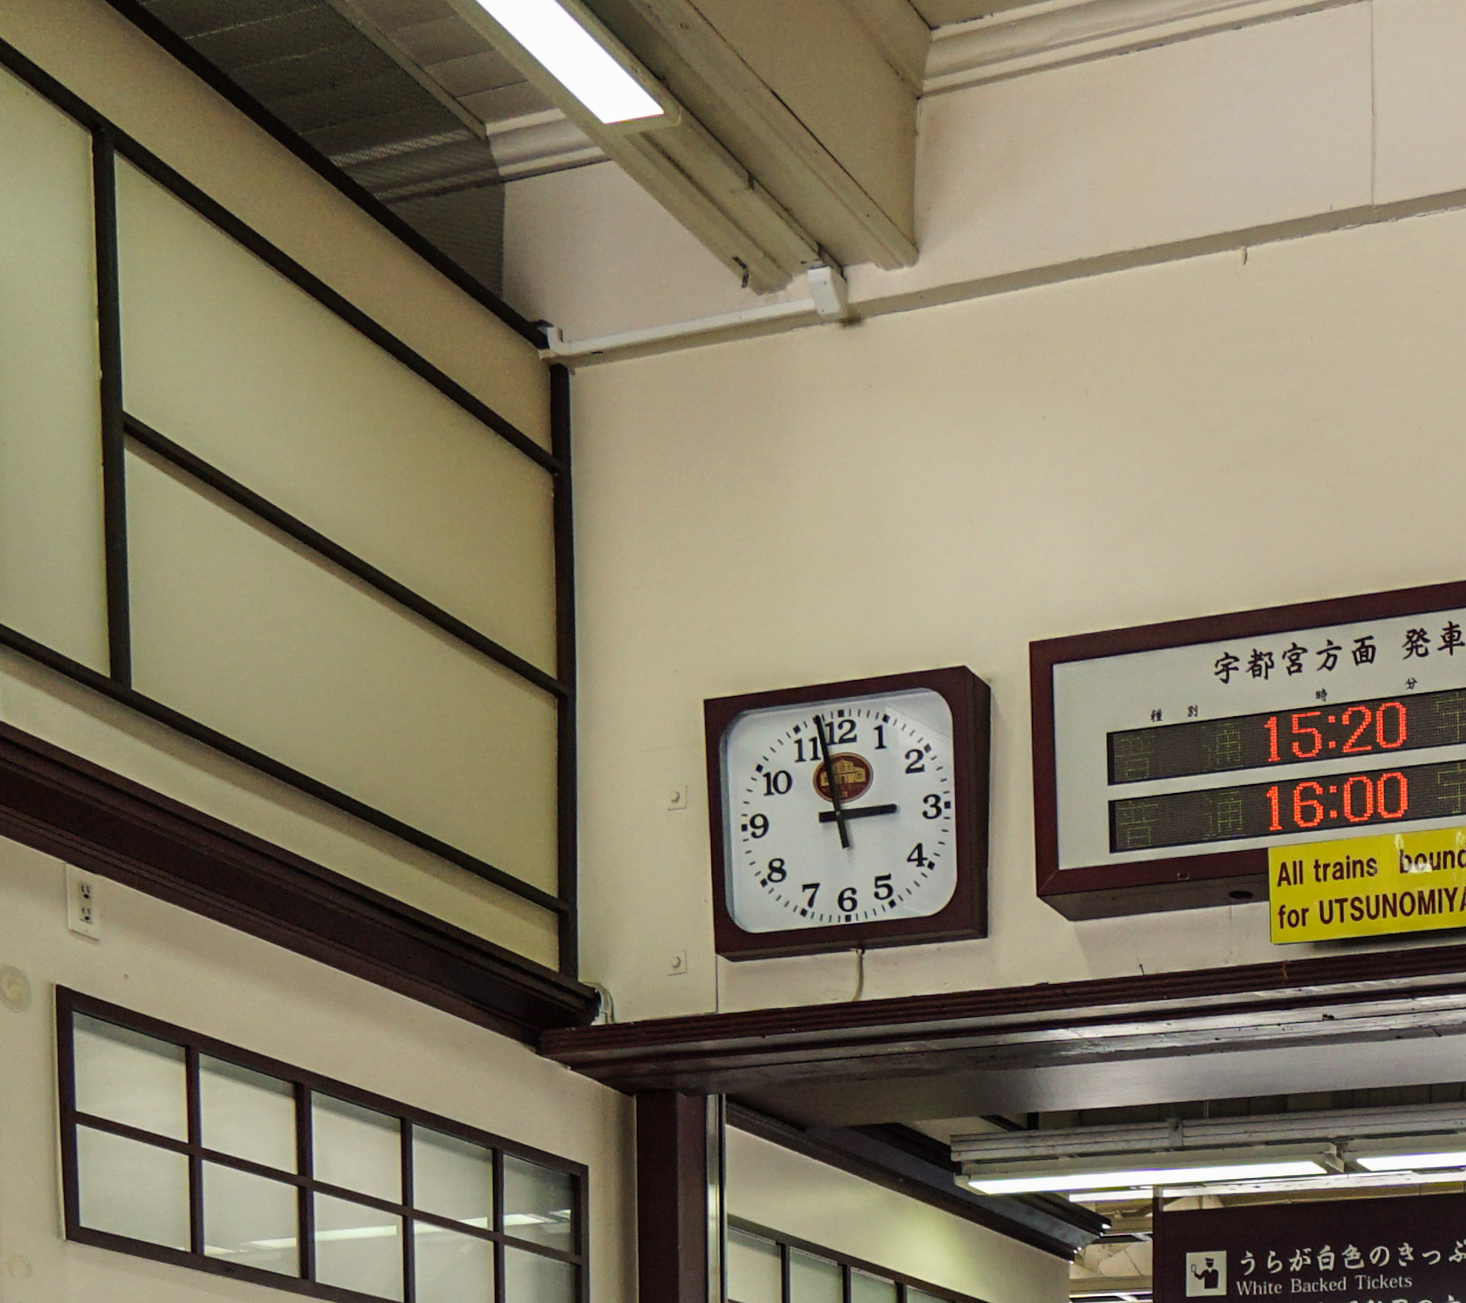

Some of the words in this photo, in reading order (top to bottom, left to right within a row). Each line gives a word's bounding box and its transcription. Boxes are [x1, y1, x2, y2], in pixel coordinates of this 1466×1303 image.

[1213, 635, 1377, 684] 宇都宮方面
[825, 719, 858, 747] 12
[874, 725, 887, 749] 1
[1262, 701, 1408, 762] 15:20
[794, 736, 821, 763] 11
[904, 749, 925, 774] 2
[762, 770, 794, 796] 10
[922, 794, 943, 819] 3
[1265, 771, 1409, 831] 16:00
[749, 813, 770, 839] 9
[906, 843, 928, 867] 4
[767, 858, 788, 883] 8
[1276, 852, 1307, 885] All
[1313, 853, 1379, 882] trains
[801, 883, 821, 908] 7
[837, 887, 858, 912] 6
[874, 873, 894, 900] 5
[1277, 902, 1311, 931] for
[1236, 1280, 1283, 1297] White
[1290, 1276, 1348, 1294] Backed
[1354, 1274, 1413, 1290] Tickets
